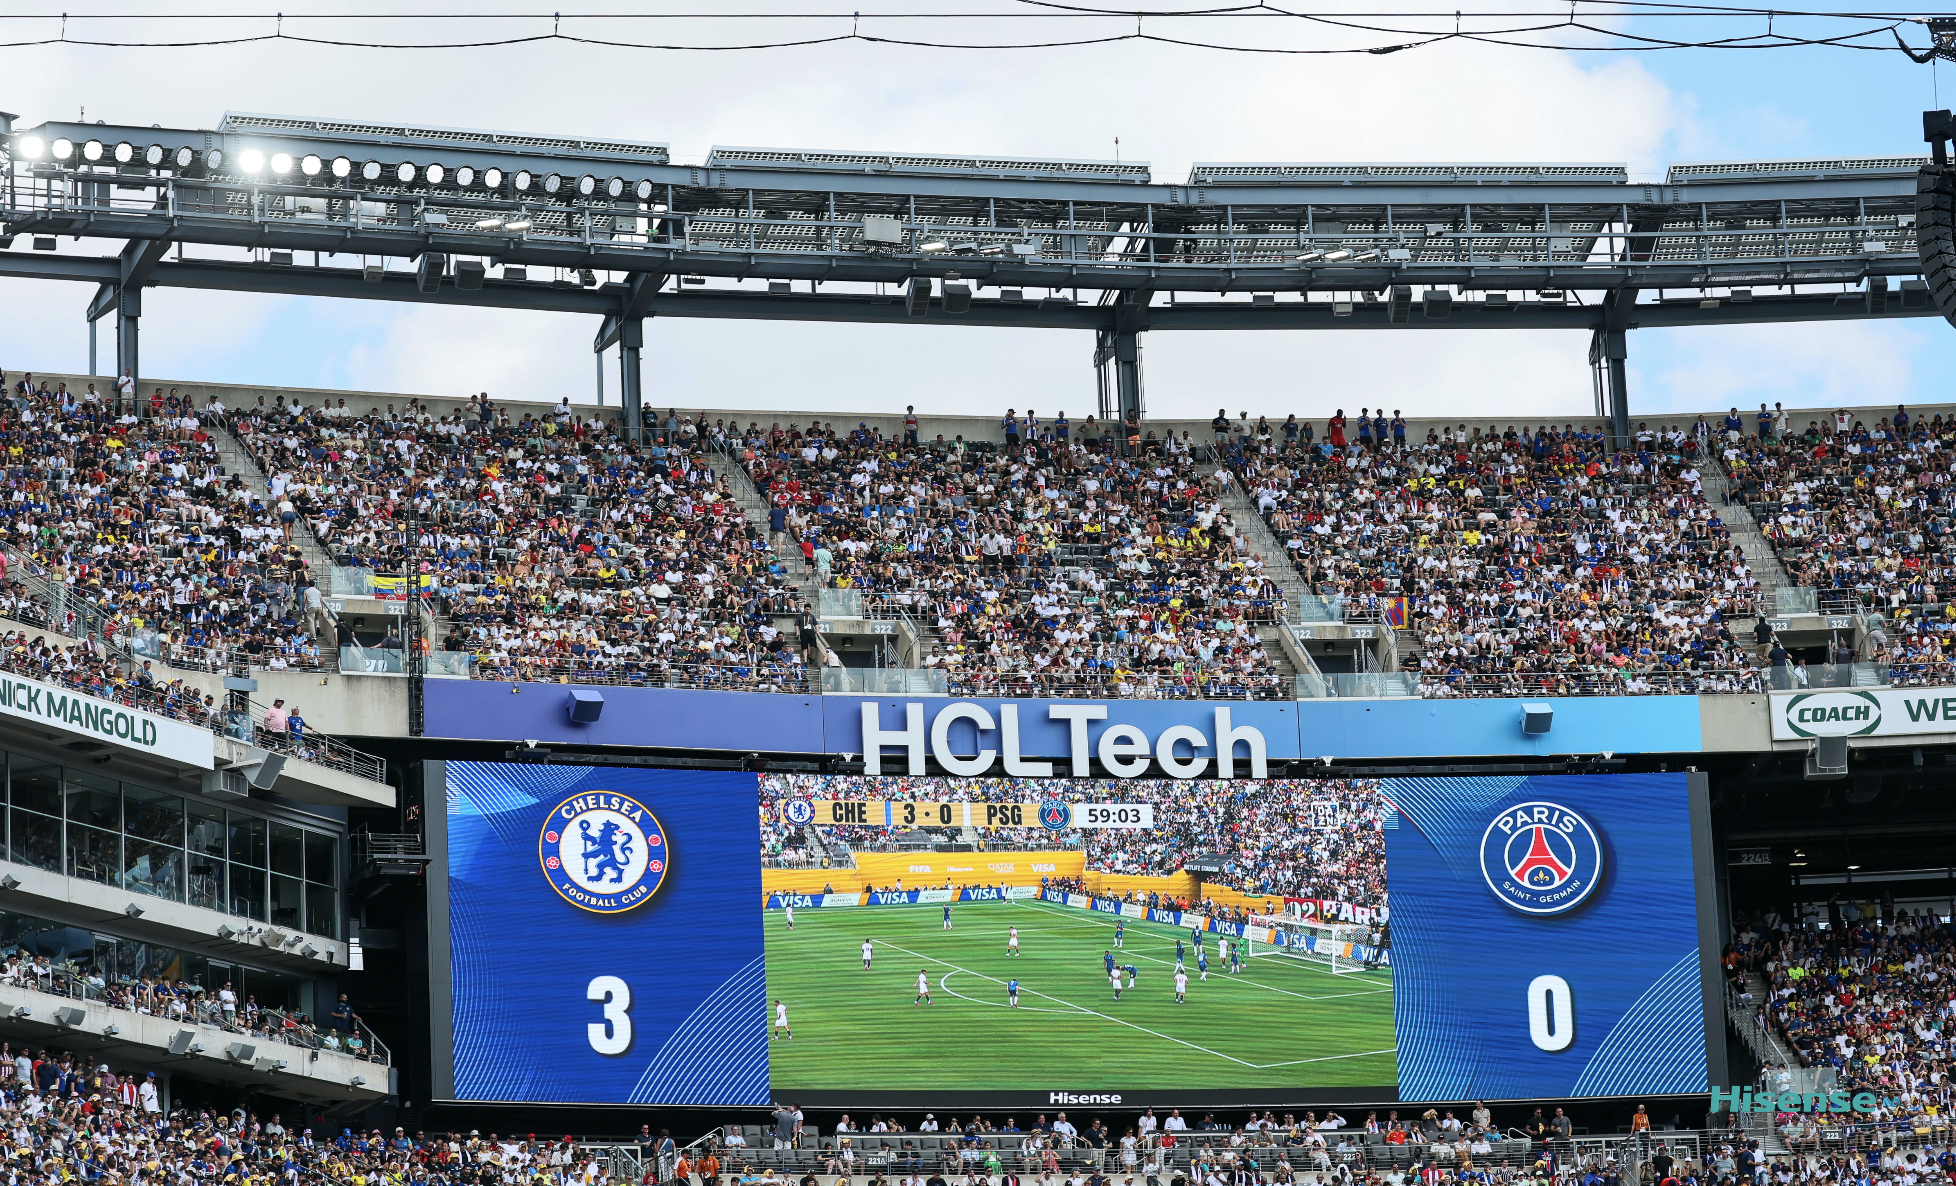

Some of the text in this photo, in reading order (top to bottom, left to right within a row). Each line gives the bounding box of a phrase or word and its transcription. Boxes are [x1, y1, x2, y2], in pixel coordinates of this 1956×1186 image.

[326, 602, 341, 611] 20
[388, 605, 405, 614] 321
[818, 624, 830, 633] 21
[874, 625, 892, 633] 322
[1770, 622, 1788, 631] 323
[1831, 620, 1848, 628] 324
[1355, 629, 1373, 638] 323
[1798, 705, 1870, 723] COACH
[1904, 698, 1956, 722] WE
[47, 691, 157, 746] MANGOLD
[861, 702, 1267, 779] HCLTech
[561, 795, 643, 824] CHELSEA
[832, 802, 1022, 826] CHE 3 0 PSG
[1088, 808, 1141, 823] 59:03
[1497, 807, 1578, 835] PARIS
[1741, 853, 1769, 863] 224B
[909, 865, 932, 873] FIFA
[987, 863, 1014, 871] QATAR
[1030, 863, 1056, 872] VISA
[562, 882, 648, 907] FOOTBALL CLUB
[875, 891, 909, 904] VISA
[967, 888, 998, 900] VISA
[1045, 888, 1064, 903] VISA
[1503, 879, 1582, 903] SAINT GERMAIN
[776, 895, 813, 907] VISA
[1095, 898, 1116, 914] VISA
[1152, 908, 1175, 925] VISA
[1214, 919, 1238, 936] VISA
[586, 975, 632, 1055] 3
[1527, 974, 1573, 1051] 0
[1049, 1092, 1122, 1104] Hisense
[1826, 1132, 1839, 1140] 223
